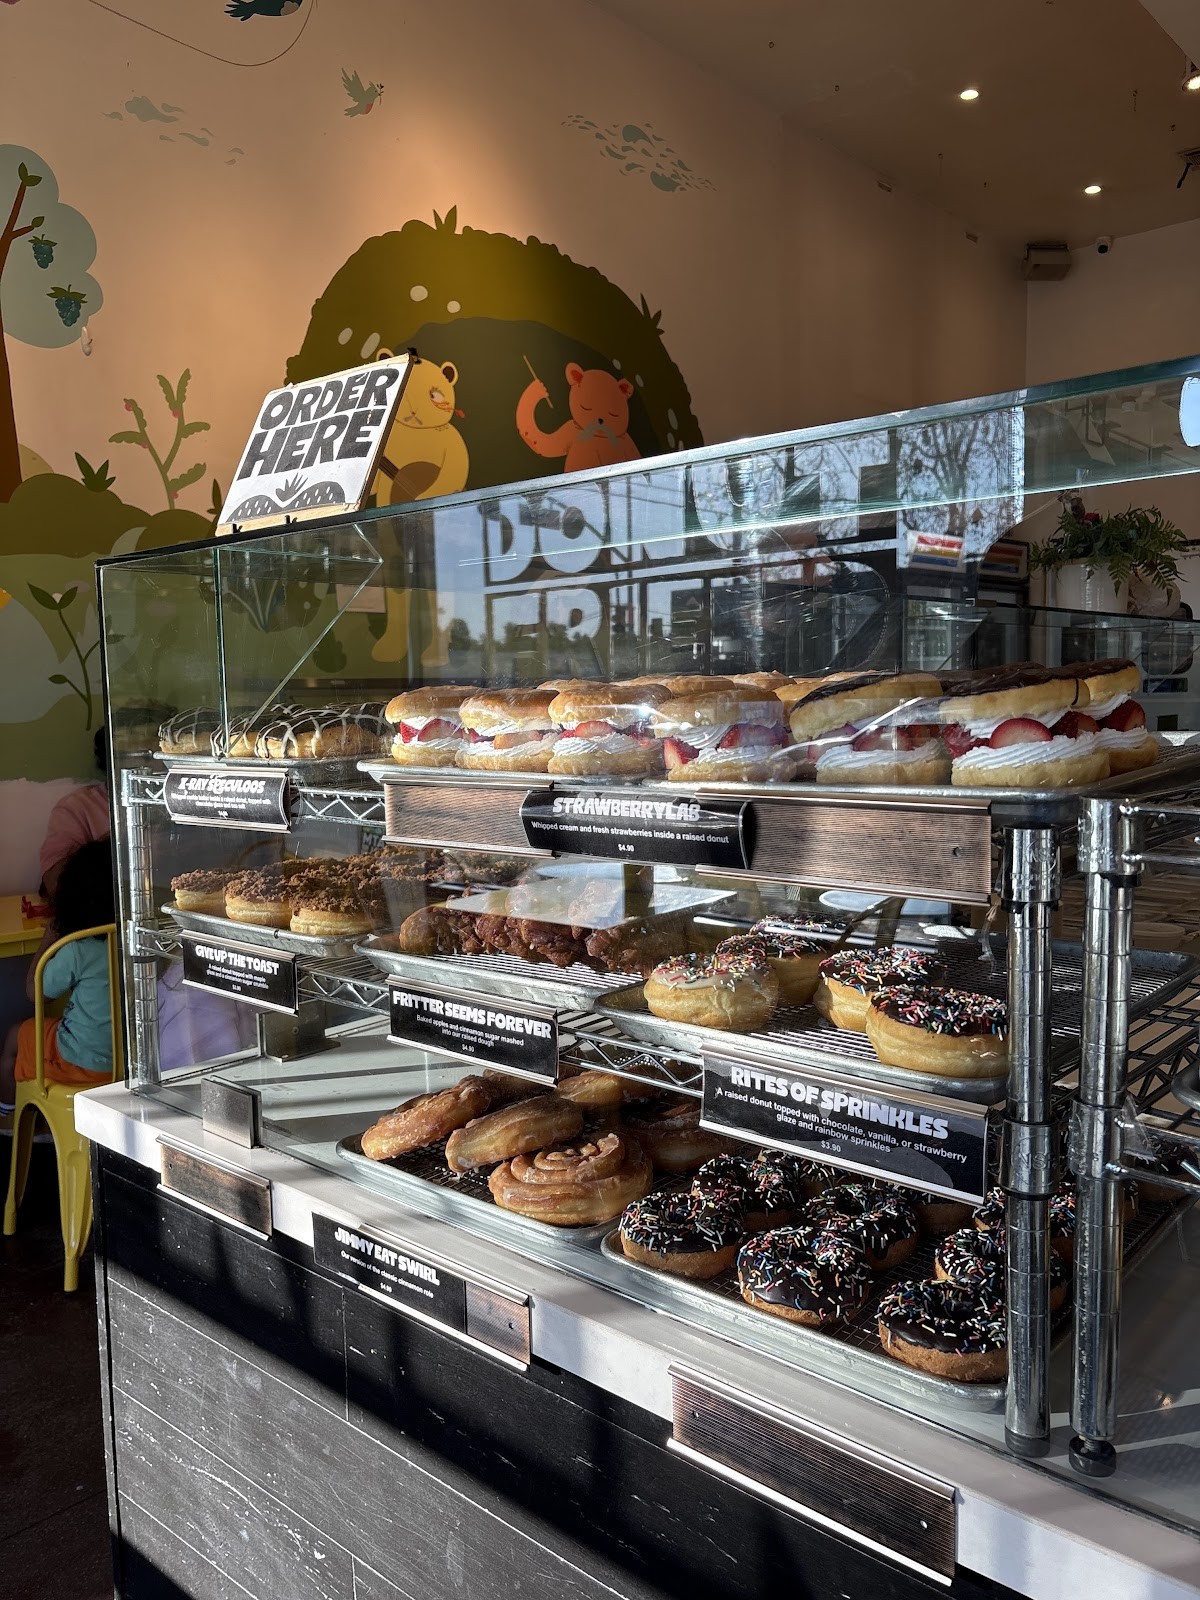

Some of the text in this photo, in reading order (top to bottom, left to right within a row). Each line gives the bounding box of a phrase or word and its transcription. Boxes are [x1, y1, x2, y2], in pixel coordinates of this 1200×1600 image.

[259, 368, 400, 431] ORDER
[236, 408, 386, 481] HERE
[178, 777, 210, 791] X-RAY
[552, 796, 700, 822] STRAWBERRYLAB
[531, 820, 559, 831] Whipped
[559, 824, 579, 832] cream
[579, 825, 592, 833] and
[593, 826, 610, 834] fresh
[610, 827, 653, 838] strawberries
[653, 829, 675, 839] inside
[682, 832, 705, 842] raised
[706, 834, 730, 843] donut
[617, 843, 635, 852] $4.90
[195, 944, 279, 975] GIVE UP THE TOAST
[393, 990, 553, 1039] FRITTER SEEMS FOREVER
[416, 1014, 524, 1047] Baked apples and cinnamon sugar mashed
[441, 1028, 452, 1036] into
[461, 1033, 478, 1043] raised
[477, 1037, 495, 1048] dough
[731, 1066, 949, 1140] RITES OF SPRINKLES
[716, 1087, 967, 1164] A raised donut topped with chocolate, vanilla, or strawberry
[776, 1112, 891, 1153] glaze and rainbow sprinkles
[820, 1139, 842, 1153] $3.90
[334, 1226, 441, 1286] JIMMY EAT SWIRL
[340, 1250, 350, 1260] Our
[380, 1269, 398, 1283] classic
[397, 1277, 424, 1294] cinnamon
